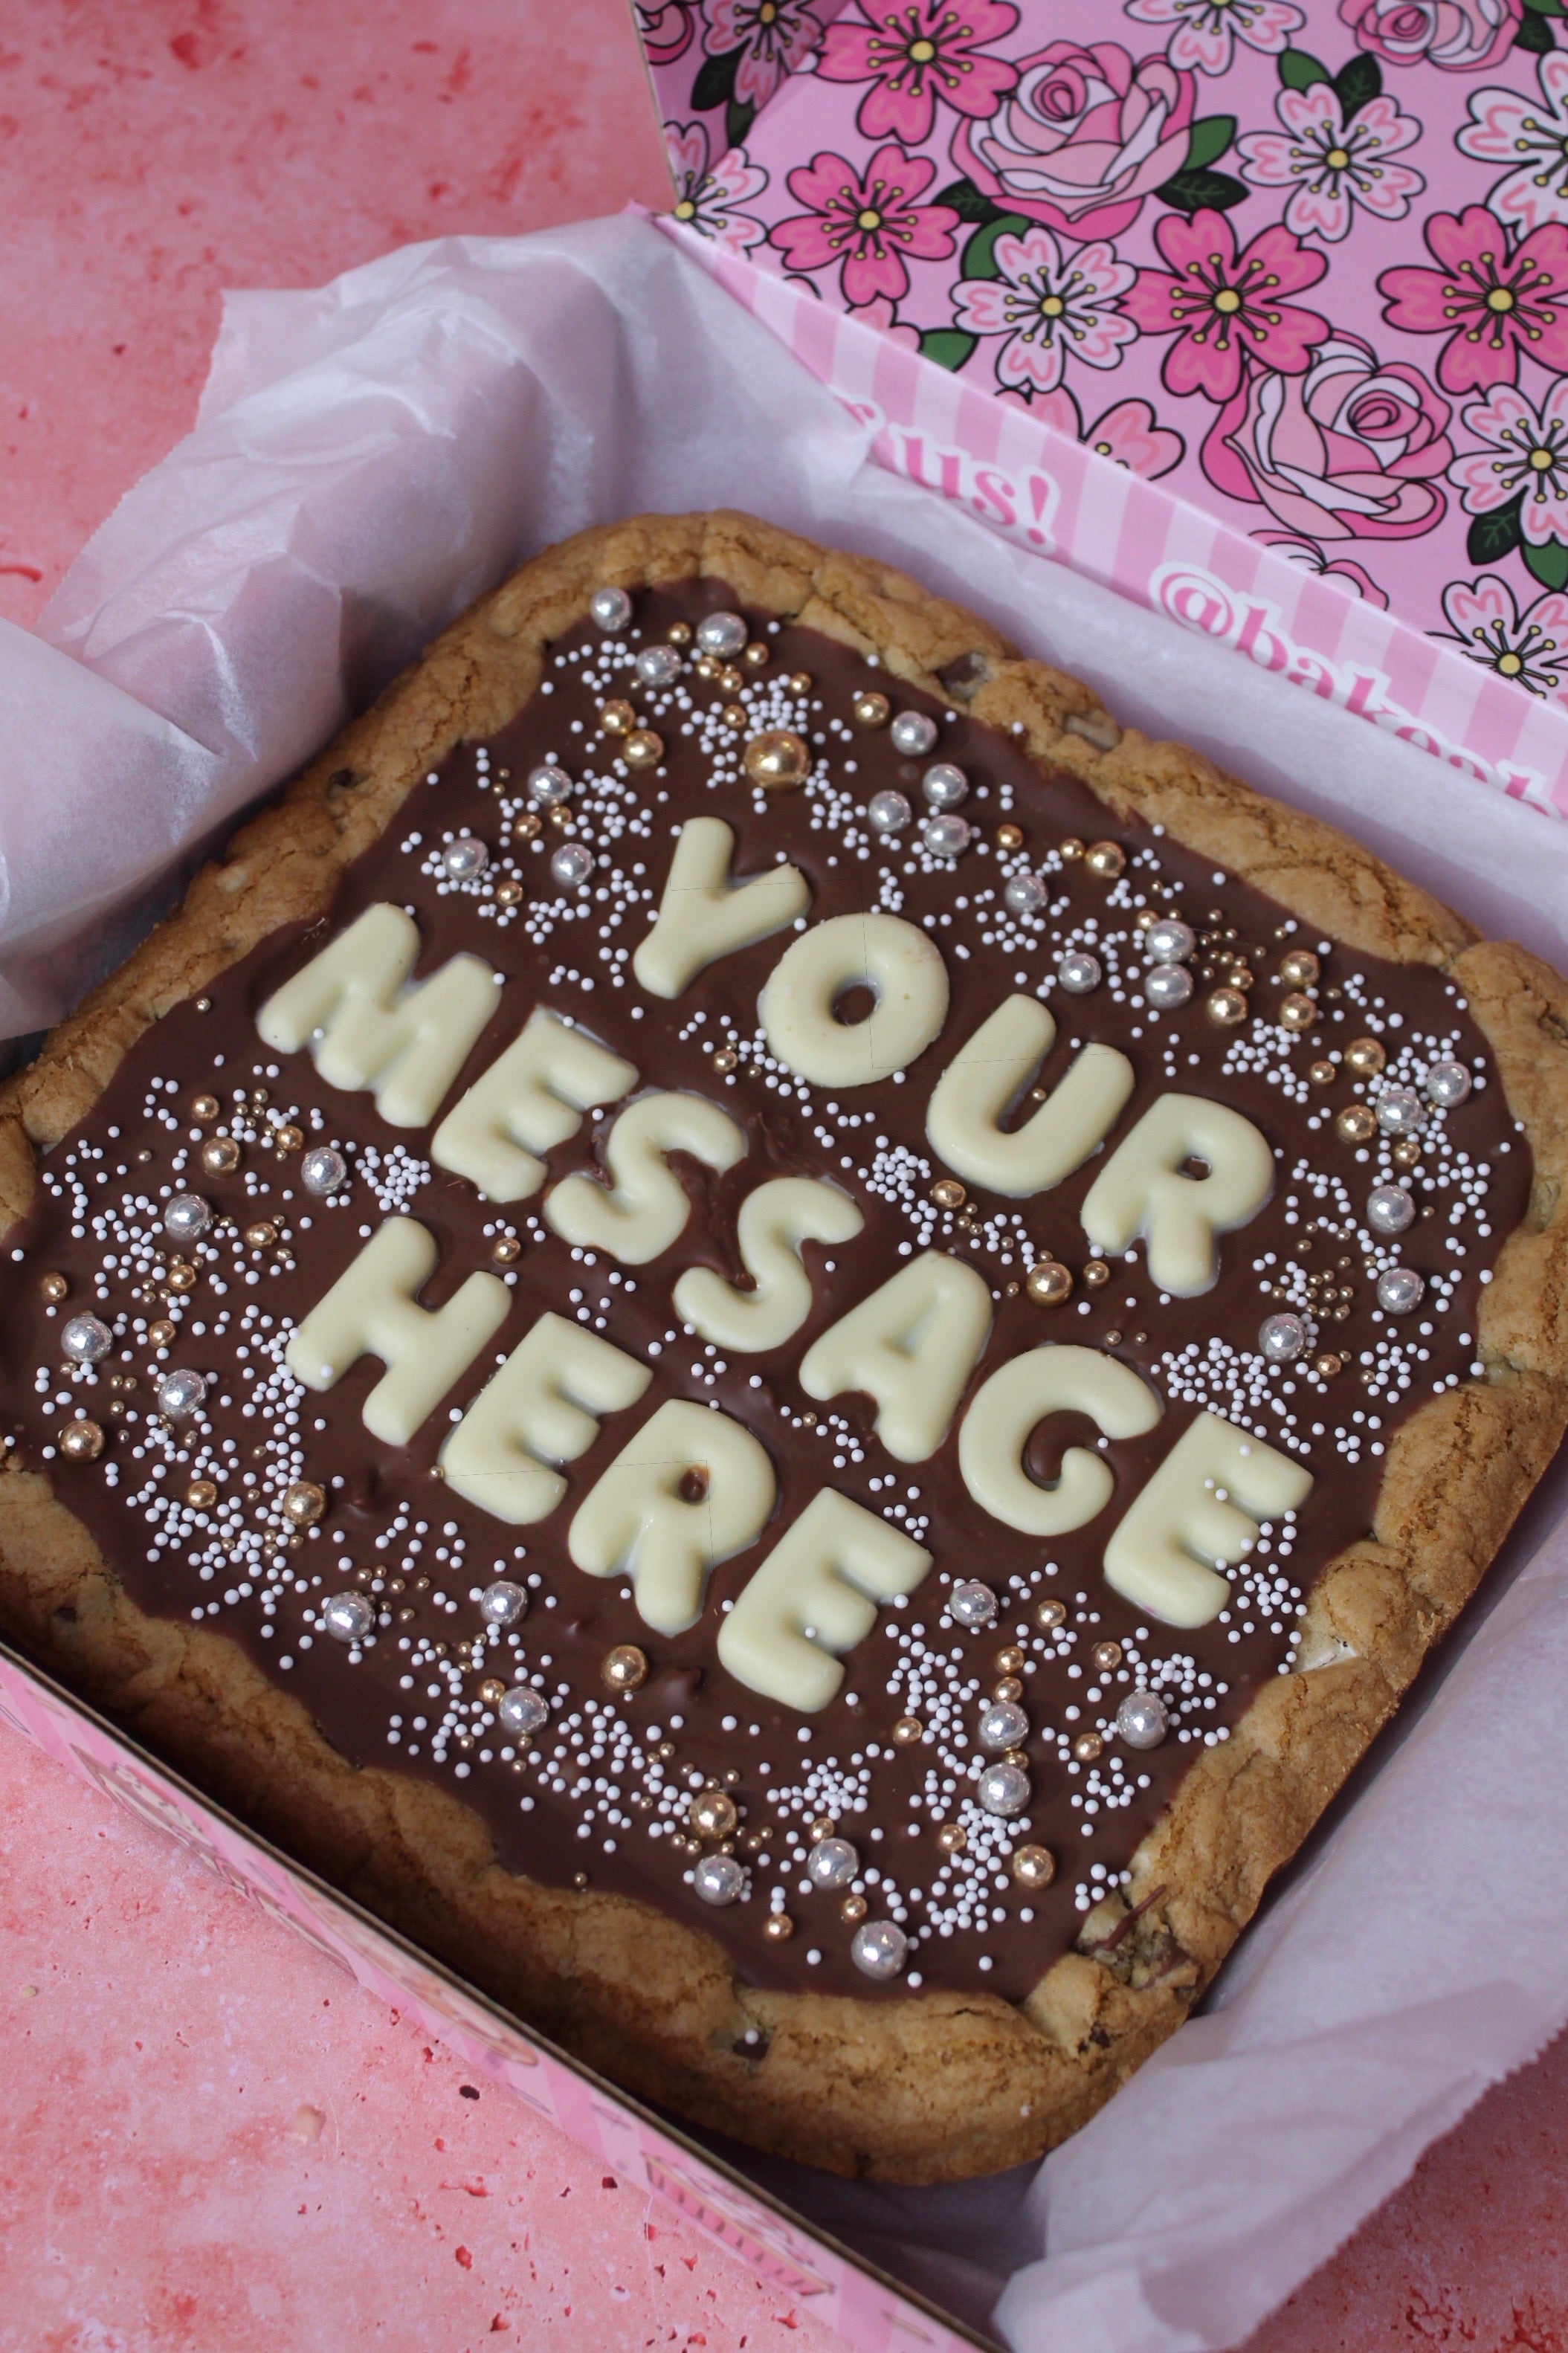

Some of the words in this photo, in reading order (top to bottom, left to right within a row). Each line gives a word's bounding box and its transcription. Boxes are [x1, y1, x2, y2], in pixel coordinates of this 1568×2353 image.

[900, 433, 1049, 545] us!
[1159, 572, 1551, 817] @bak
[257, 903, 1314, 1629] MESSAGE
[633, 816, 1276, 1298] YOUR
[288, 1216, 934, 1714] HERE
